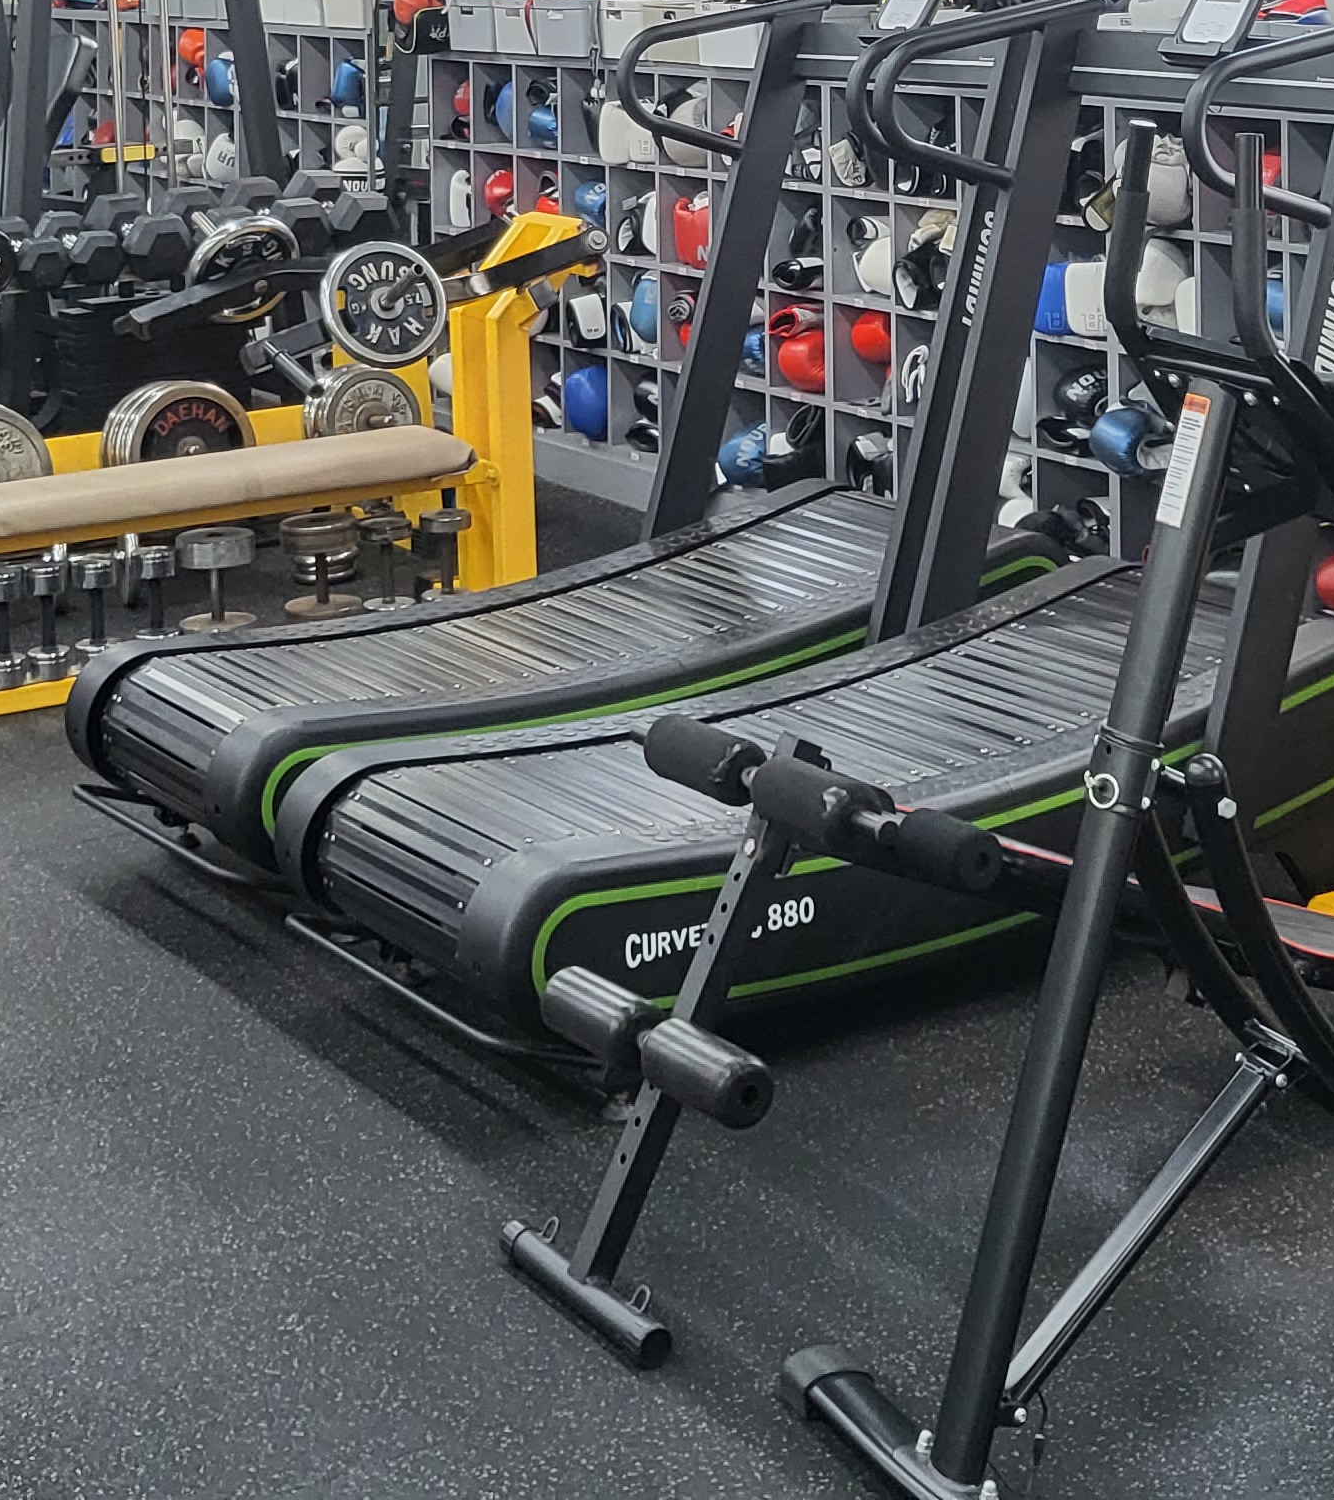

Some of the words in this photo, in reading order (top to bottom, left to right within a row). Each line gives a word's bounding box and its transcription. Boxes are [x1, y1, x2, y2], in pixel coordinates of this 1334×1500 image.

[365, 316, 425, 346] HAK
[154, 402, 230, 437] DAEHAN
[767, 896, 815, 931] 880
